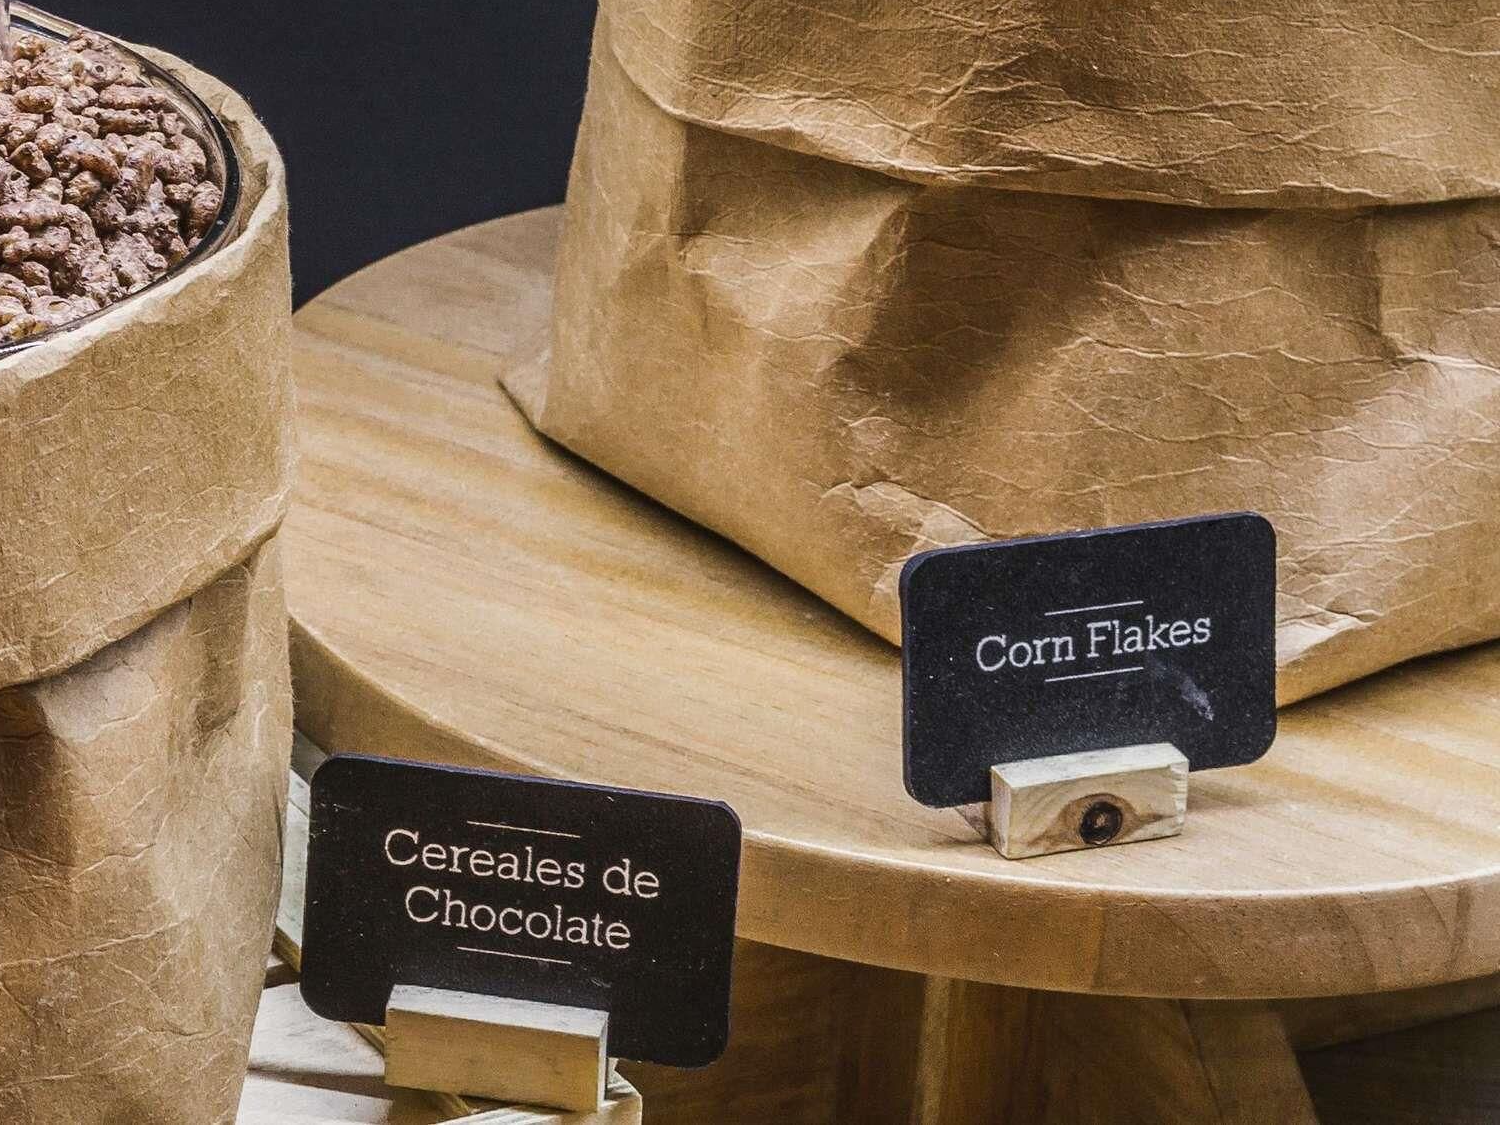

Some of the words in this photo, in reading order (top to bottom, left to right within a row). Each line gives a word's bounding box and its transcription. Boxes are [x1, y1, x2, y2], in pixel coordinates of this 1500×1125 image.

[975, 634, 1076, 672] Corn
[1086, 614, 1212, 658] Flakes
[384, 828, 586, 889] Cereales
[602, 858, 660, 899] de
[405, 885, 631, 950] Chocolate
